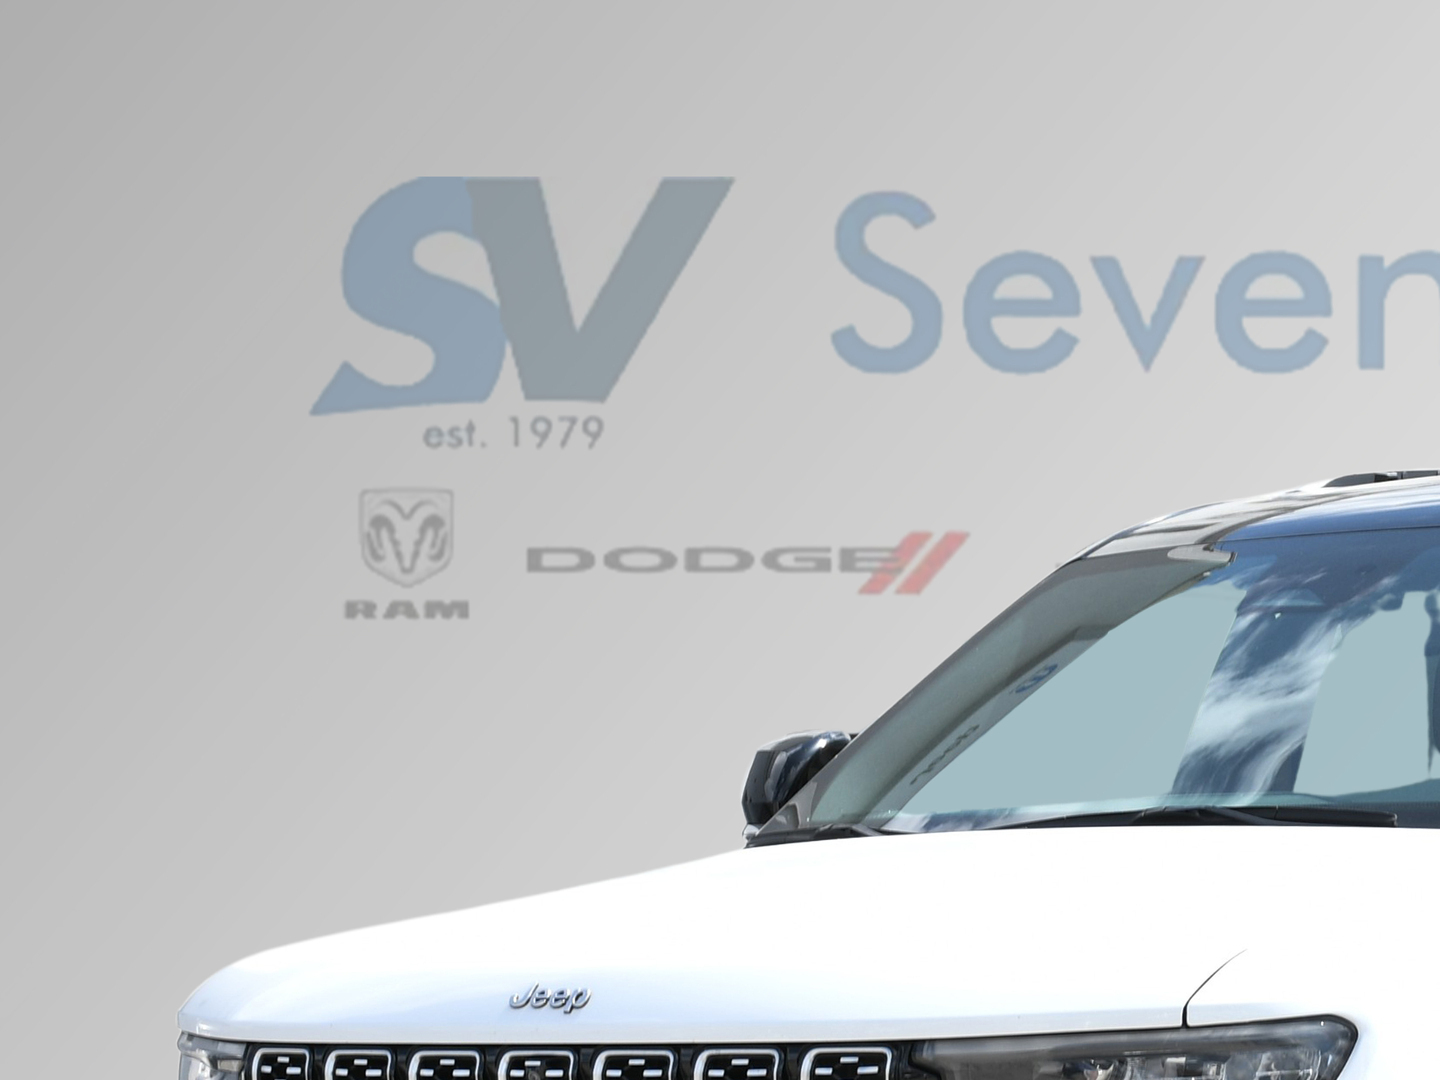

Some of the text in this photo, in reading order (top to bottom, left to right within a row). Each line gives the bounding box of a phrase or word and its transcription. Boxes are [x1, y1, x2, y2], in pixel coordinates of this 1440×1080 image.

[308, 176, 736, 416] SV
[422, 415, 605, 450] est. 1979
[526, 546, 906, 573] DODGE
[344, 600, 470, 620] RAM
[508, 981, 592, 1014] Jeep
